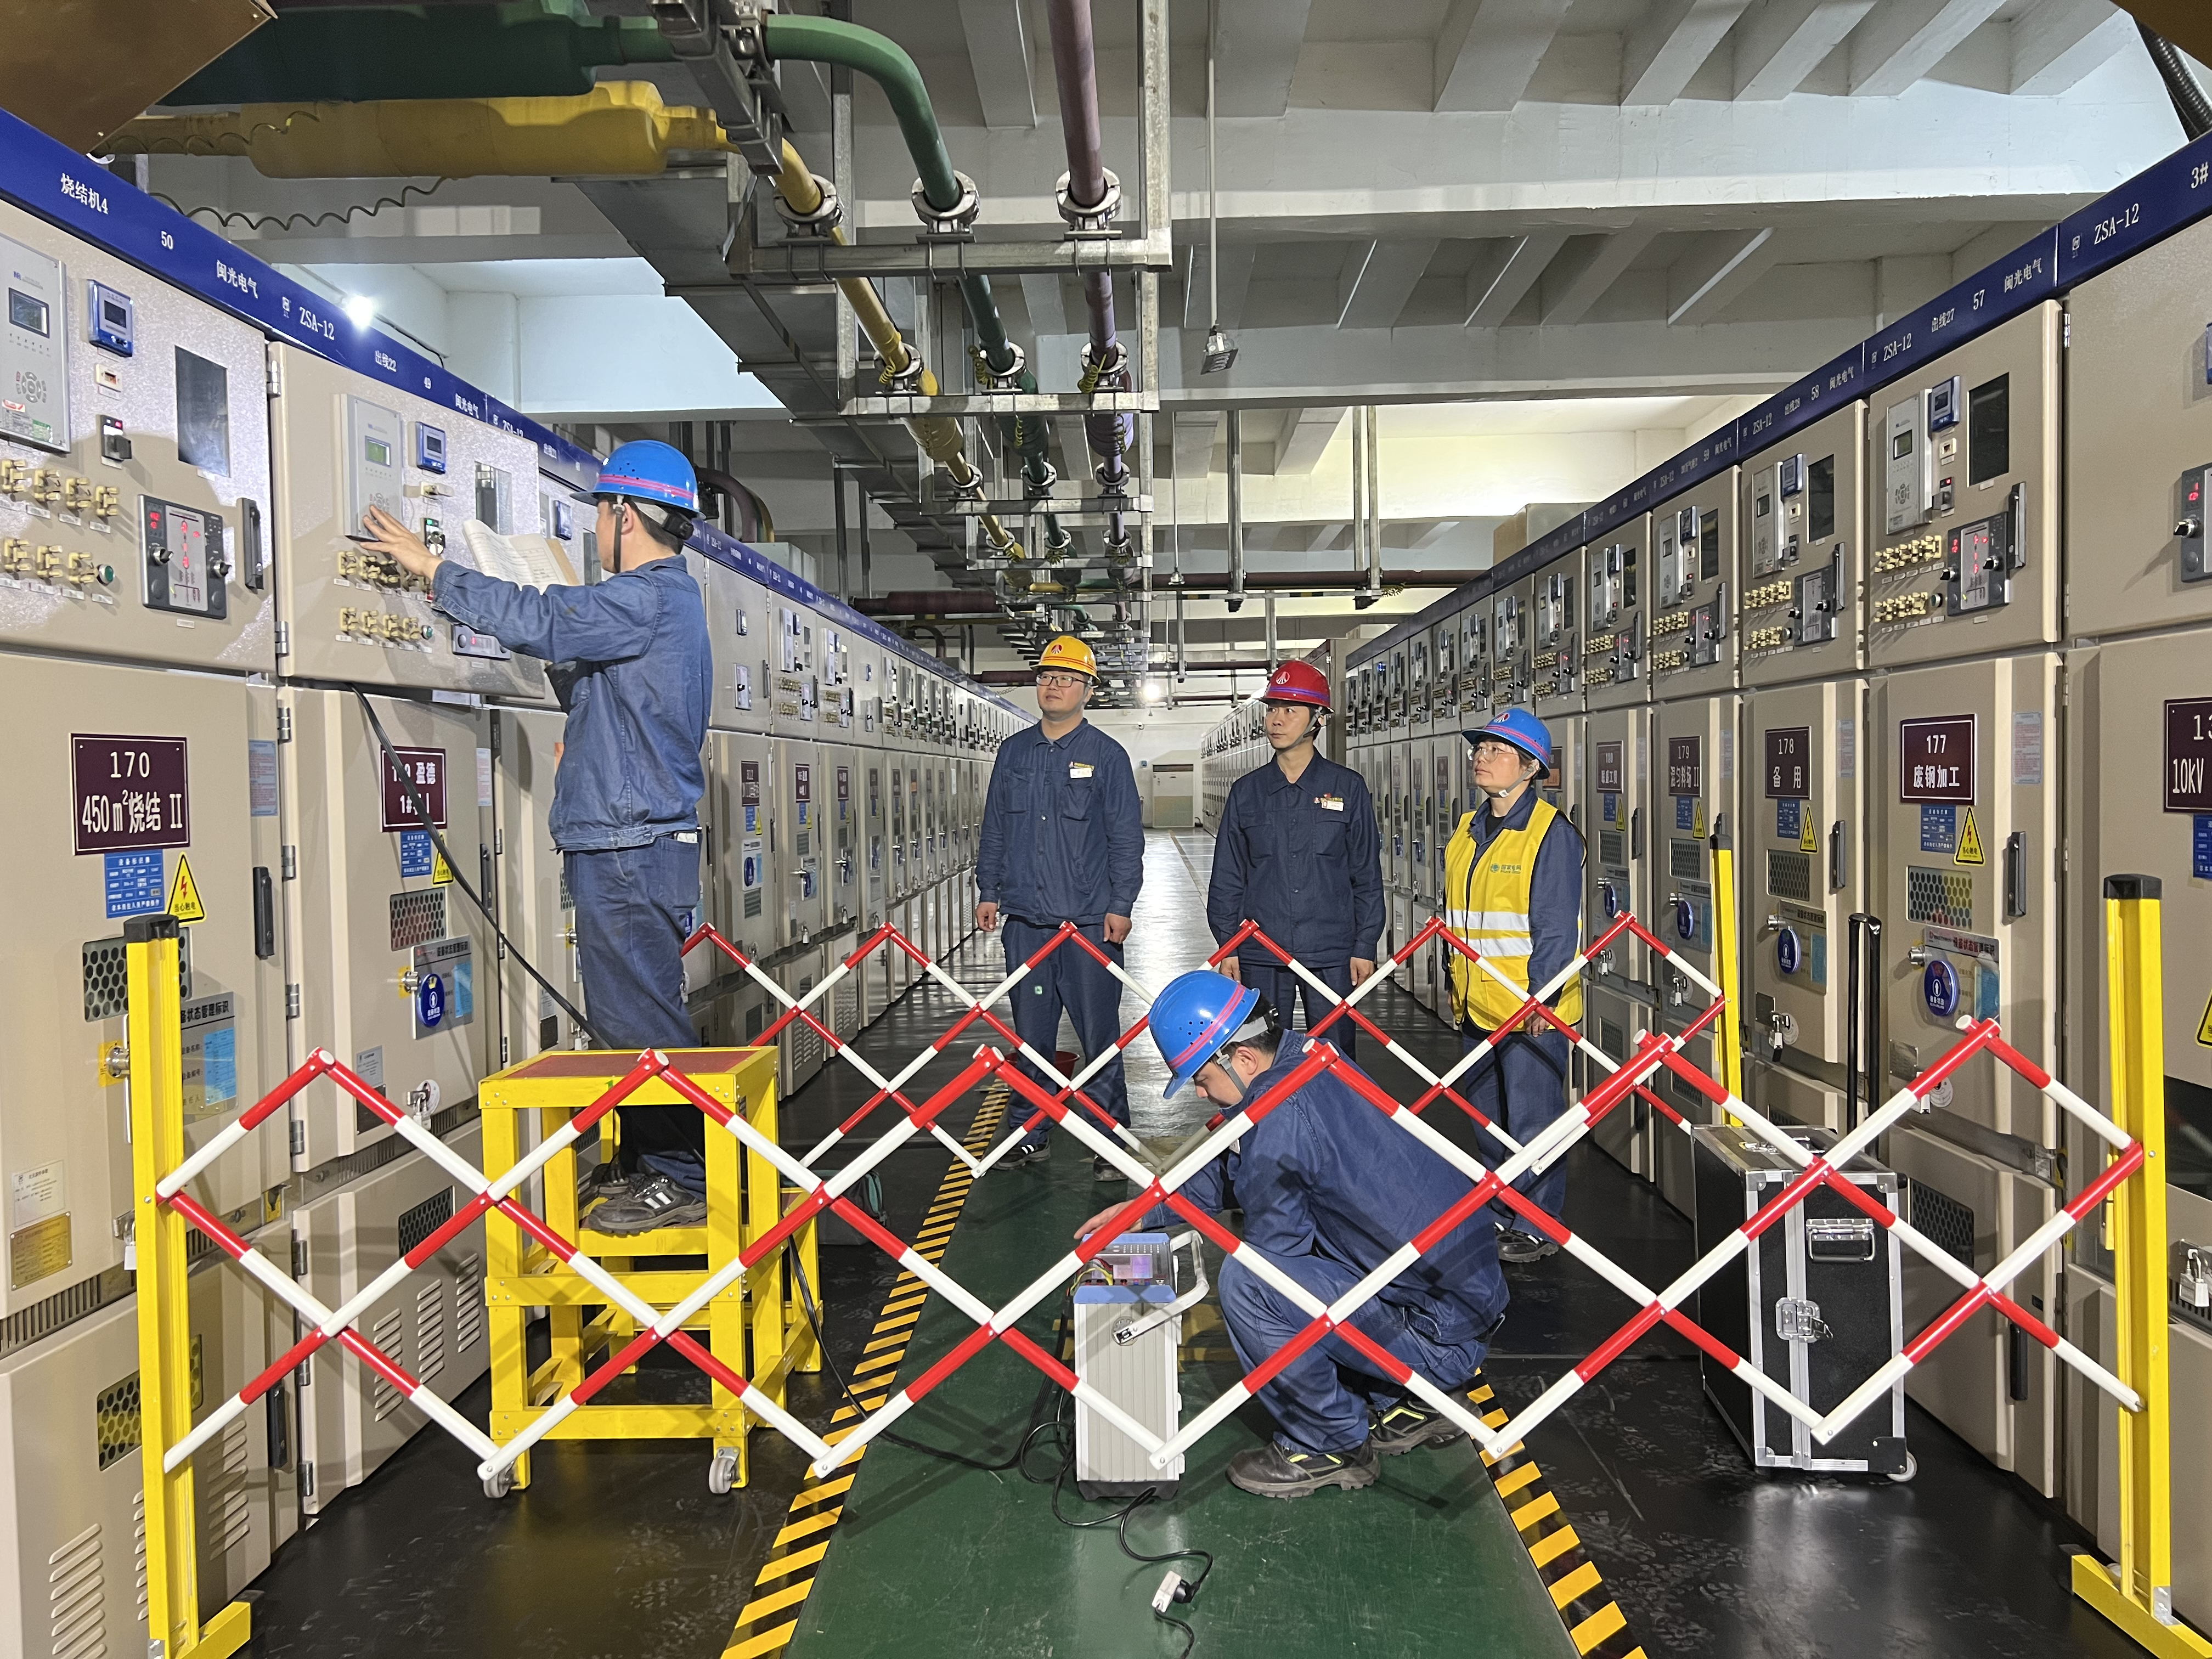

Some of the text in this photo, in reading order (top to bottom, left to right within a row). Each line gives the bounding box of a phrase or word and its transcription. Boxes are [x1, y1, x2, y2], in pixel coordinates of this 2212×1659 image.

[2095, 162, 2209, 245] ZSA-12 3#
[61, 173, 258, 299] 烧结机4 50 闽光电气
[1883, 258, 2042, 362] ZSA-12 出线27 57 闽光电气
[300, 306, 335, 340] ZSA-12
[455, 393, 479, 419] 闽光电气
[1753, 413, 1773, 435] ZSA-12
[1812, 385, 1819, 400] 58
[1830, 366, 1854, 391] 闽光电气
[1678, 746, 1690, 759] 179
[1778, 738, 1794, 755] 178
[1926, 735, 1946, 753] 177
[110, 752, 150, 778] 170
[392, 763, 411, 782] 19
[1773, 766, 1801, 788] 备用
[1914, 765, 1960, 788] 废钢加工
[2173, 758, 2204, 793] 10kV
